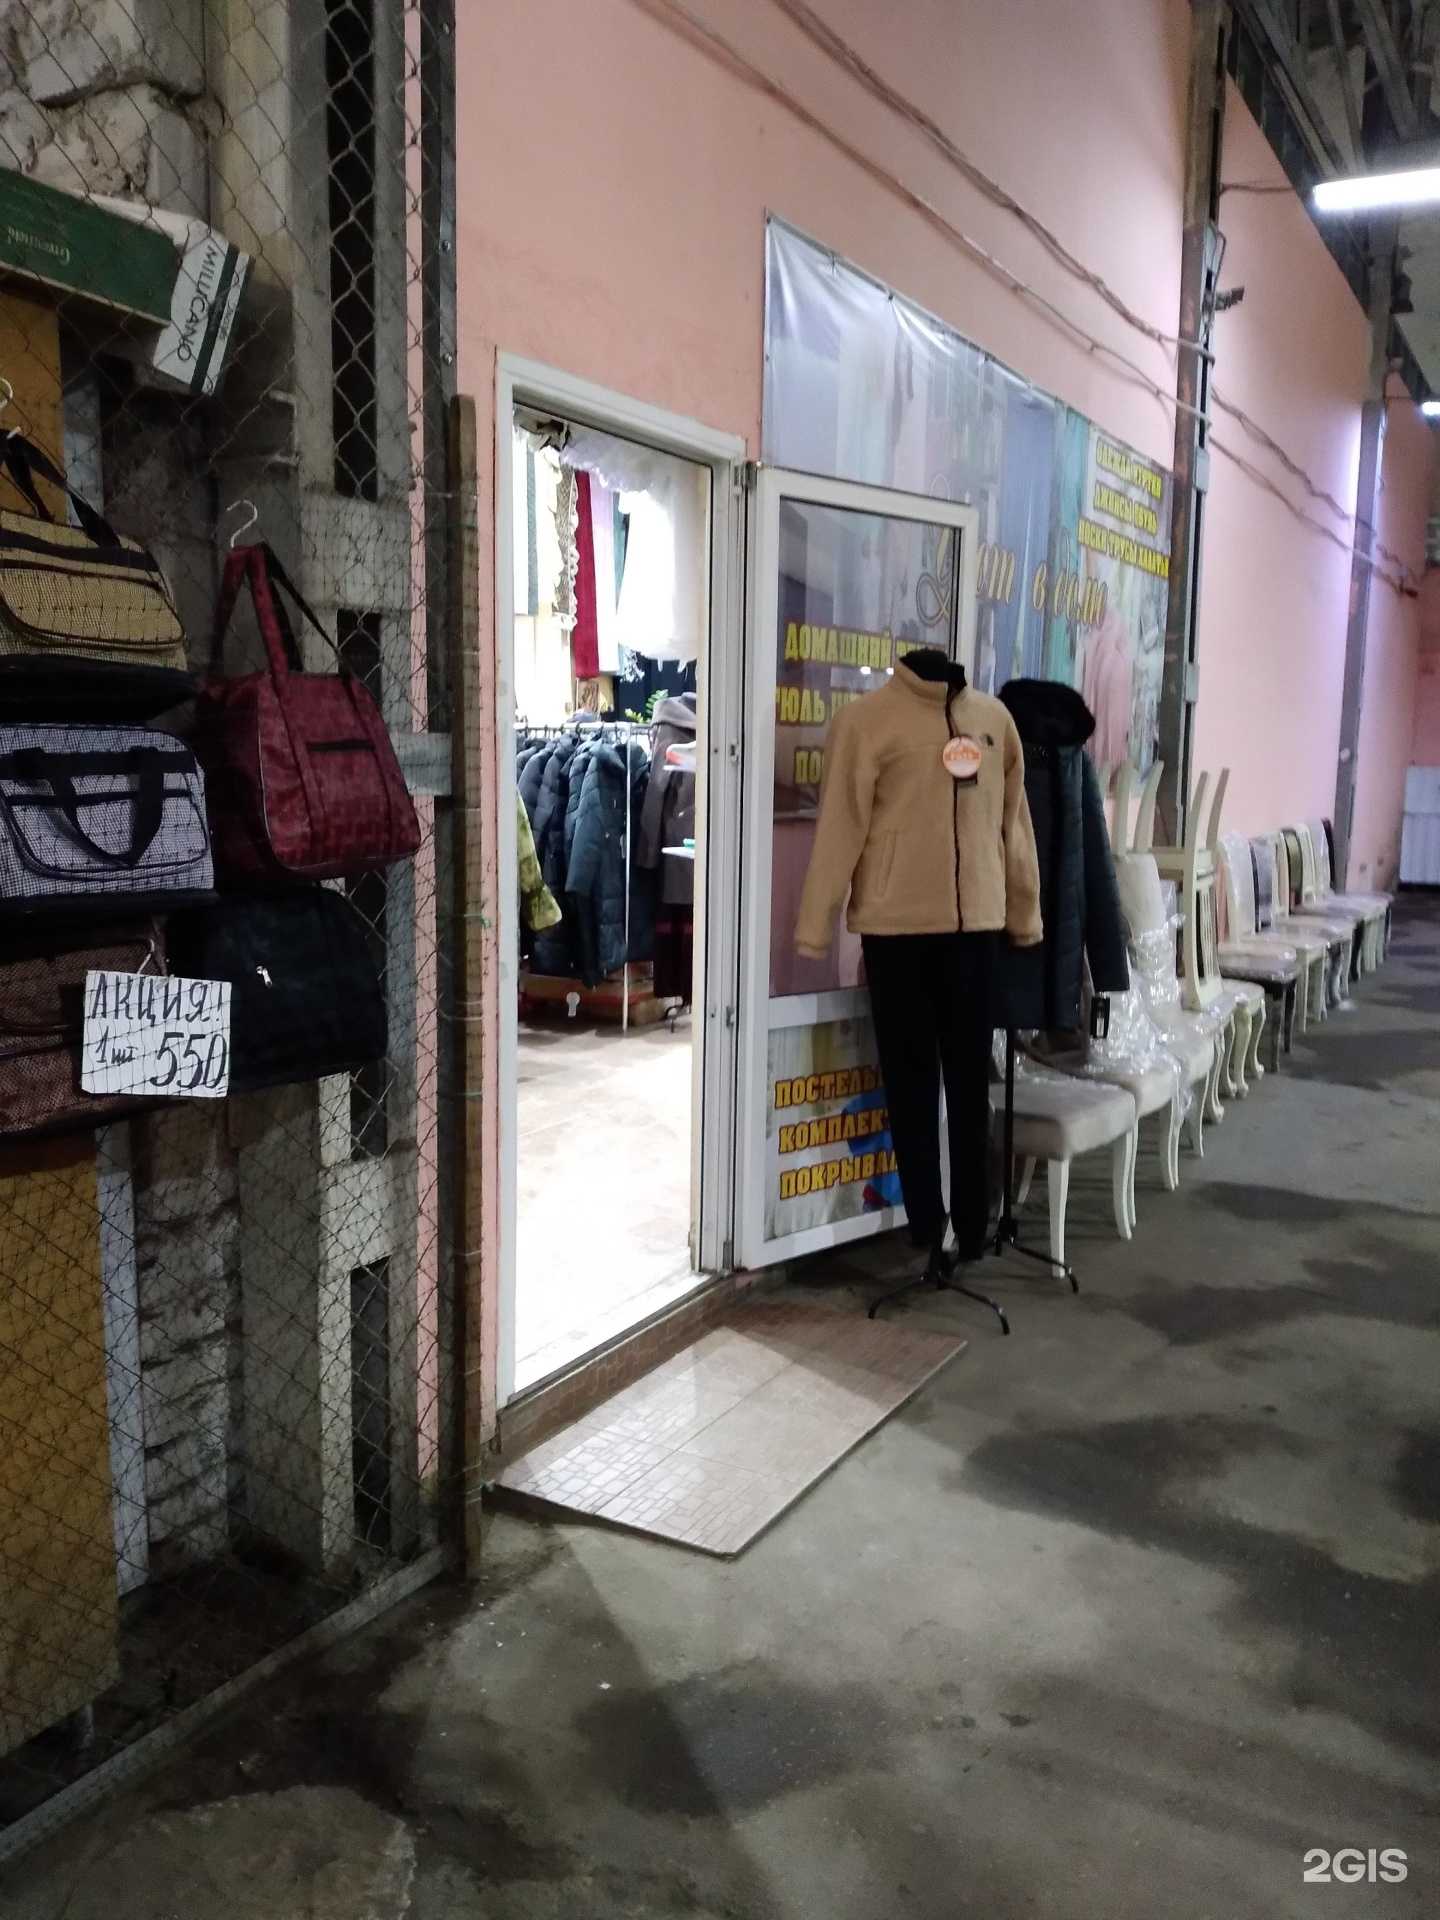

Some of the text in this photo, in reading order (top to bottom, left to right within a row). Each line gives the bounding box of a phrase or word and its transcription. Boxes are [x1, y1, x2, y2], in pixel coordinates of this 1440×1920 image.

[1133, 501, 1159, 537] ОБУВЬ
[784, 621, 893, 670] ДОМАШНИЙ
[91, 973, 224, 1028] АКЦИЯ!
[775, 1067, 882, 1108] ПОСТЕЛЬ
